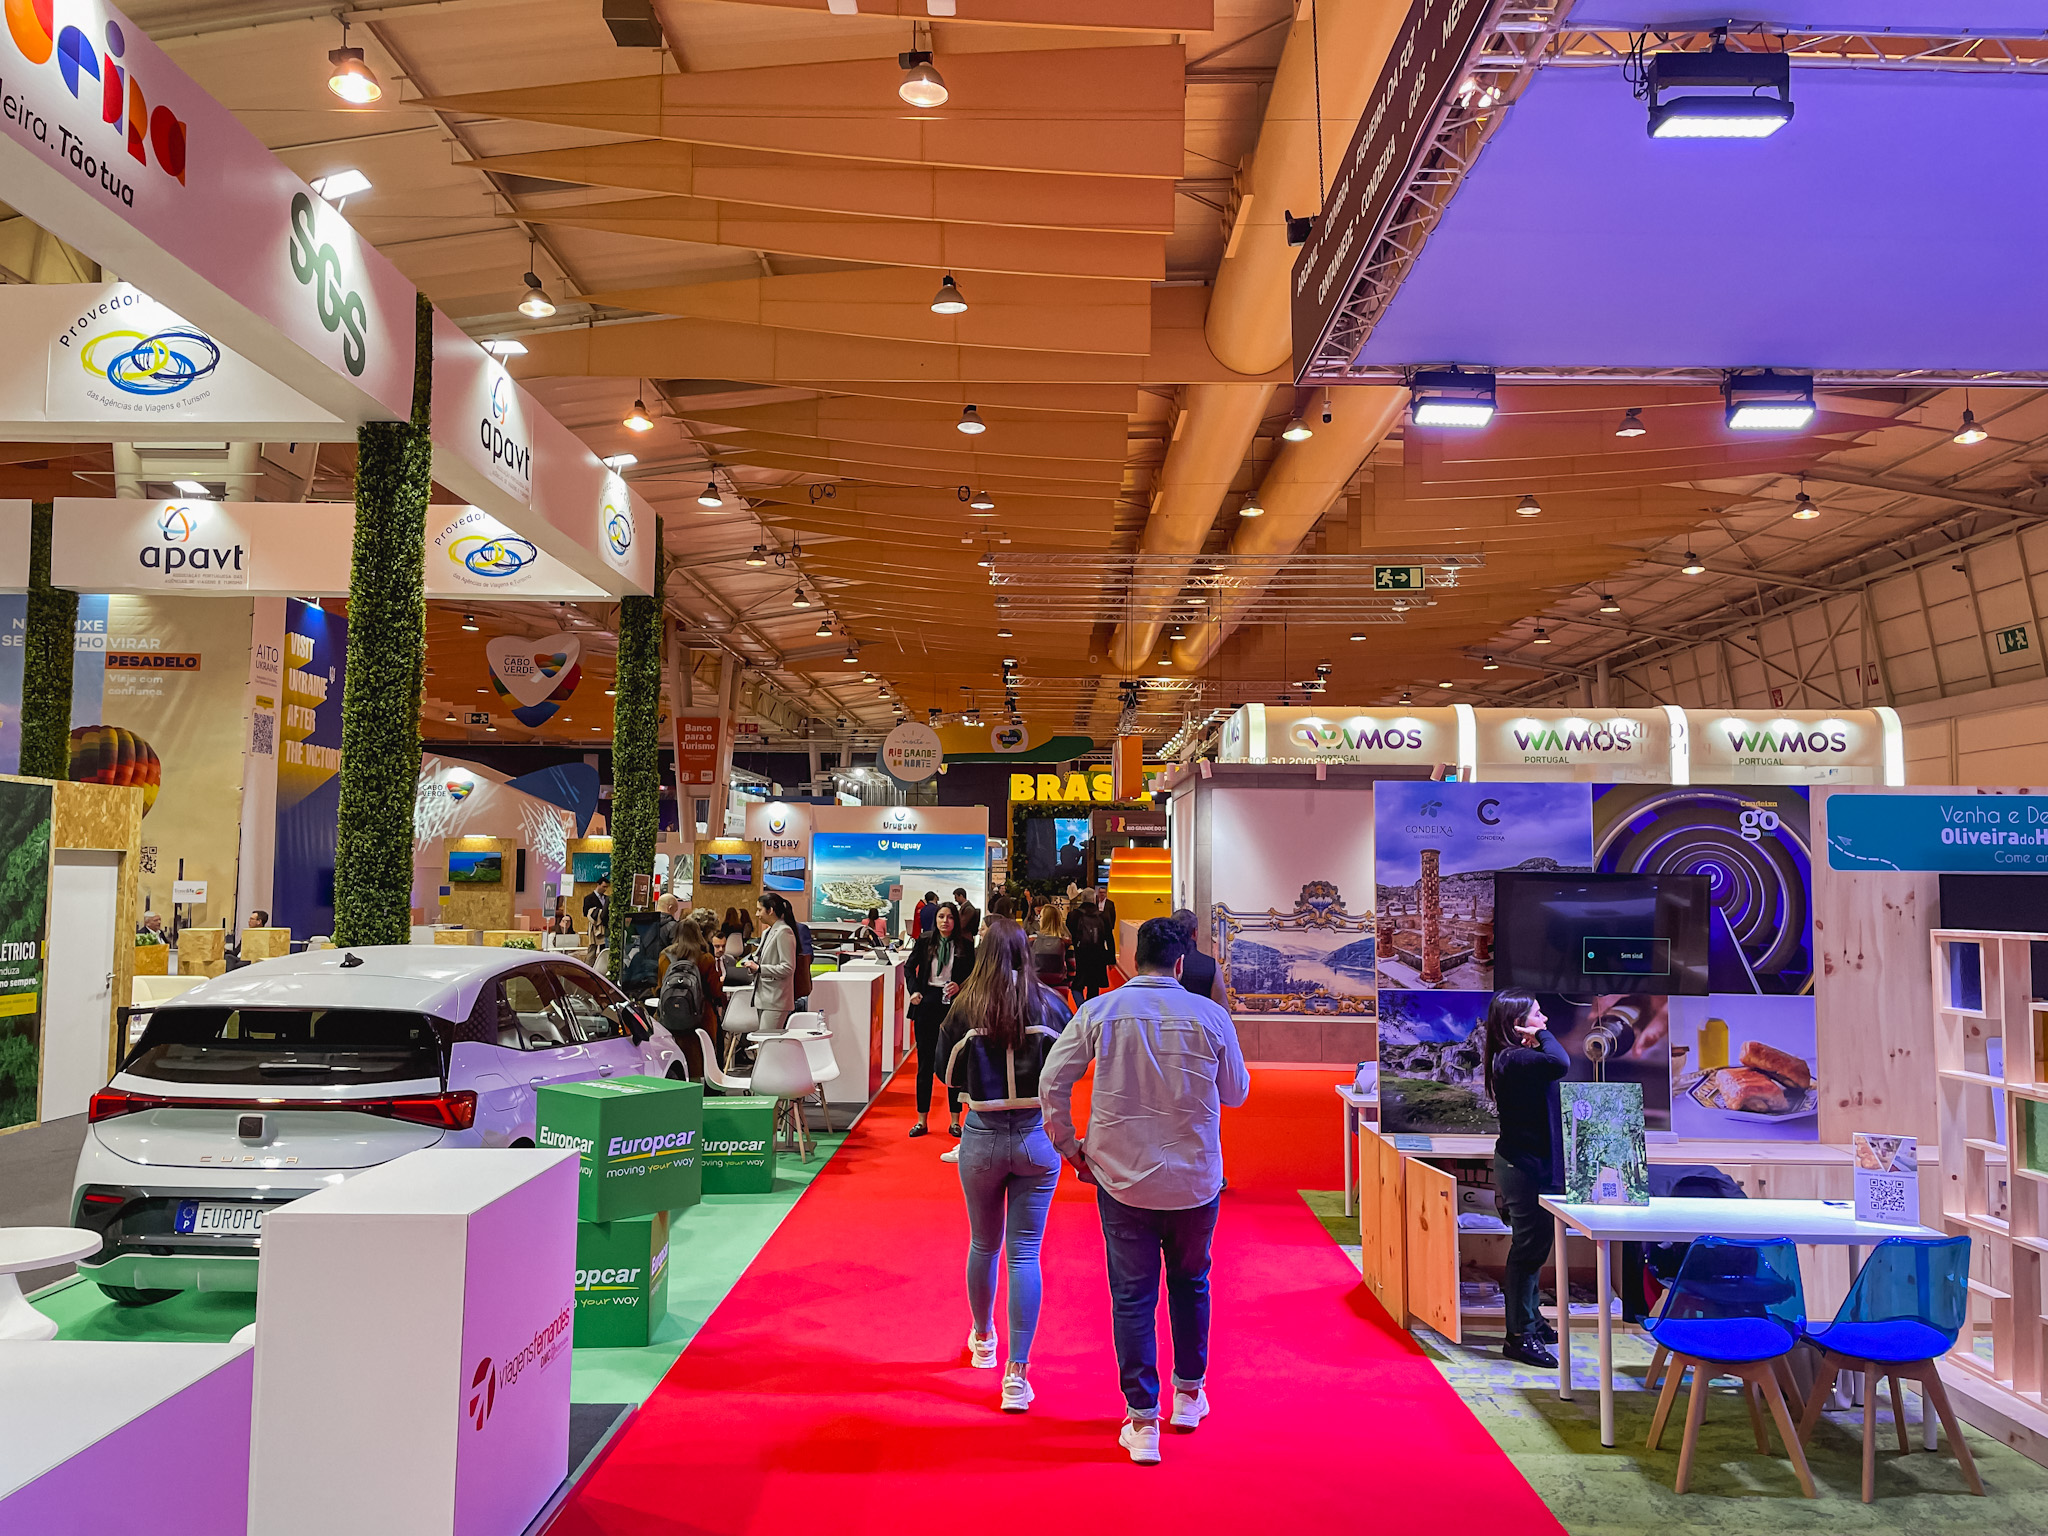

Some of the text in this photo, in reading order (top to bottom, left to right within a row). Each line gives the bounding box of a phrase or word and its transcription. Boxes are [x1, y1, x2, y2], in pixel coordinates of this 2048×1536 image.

[1356, 92, 1387, 172] FIGUEIRA
[1387, 66, 1399, 106] DA
[1399, 25, 1416, 80] FOZ
[58, 124, 97, 179] Tão
[100, 161, 134, 208] tua
[1317, 218, 1354, 306] CANTANHEDE
[1360, 133, 1397, 218] CONDEIXA
[290, 192, 367, 377] SGS
[58, 294, 143, 348] Provedor
[86, 389, 100, 402] das
[100, 396, 132, 411] Agências
[133, 404, 143, 412] de
[145, 403, 174, 413] Viagens
[182, 389, 211, 407] Turismo
[480, 418, 530, 482] apavt
[139, 544, 244, 575] apavt
[1, 635, 25, 648] SE
[109, 637, 161, 650] VIRAR
[290, 632, 315, 662] VISIT
[108, 655, 197, 668] PESADELO
[256, 643, 279, 663] AITO
[504, 658, 531, 666] CABO
[255, 660, 279, 675] UKRAINE
[109, 674, 163, 687] Viaje com
[288, 667, 328, 701] UKRAINE
[286, 704, 316, 732] AFTER
[684, 724, 712, 732] Banco
[681, 742, 716, 750] Turismo
[1513, 729, 1632, 752] WAMOS
[1727, 730, 1847, 754] WAMOS
[285, 739, 342, 771] THE VICTORY
[904, 749, 937, 758] GRANDE
[1524, 756, 1570, 764] PORTUGAL
[1739, 757, 1784, 766] PORTUGAL
[904, 759, 931, 768] NORTE
[1940, 806, 2000, 824] Venha
[2008, 811, 2020, 824] e
[883, 822, 918, 831] Uruguay
[1405, 825, 1454, 838] CONDEIXA
[1739, 810, 1780, 841] go
[892, 842, 922, 850] Uruguay
[1994, 850, 2031, 864] Come
[0, 940, 36, 962] ÉTRICO
[10, 978, 38, 988] sempre.
[540, 1126, 594, 1154] Europcar
[608, 1130, 696, 1157] Europcar
[200, 1156, 299, 1164] CUPRA
[606, 1157, 695, 1178] moving your way
[702, 1160, 724, 1168] oving
[183, 1220, 190, 1229] P
[580, 1297, 611, 1307] your
[612, 1295, 640, 1307] way
